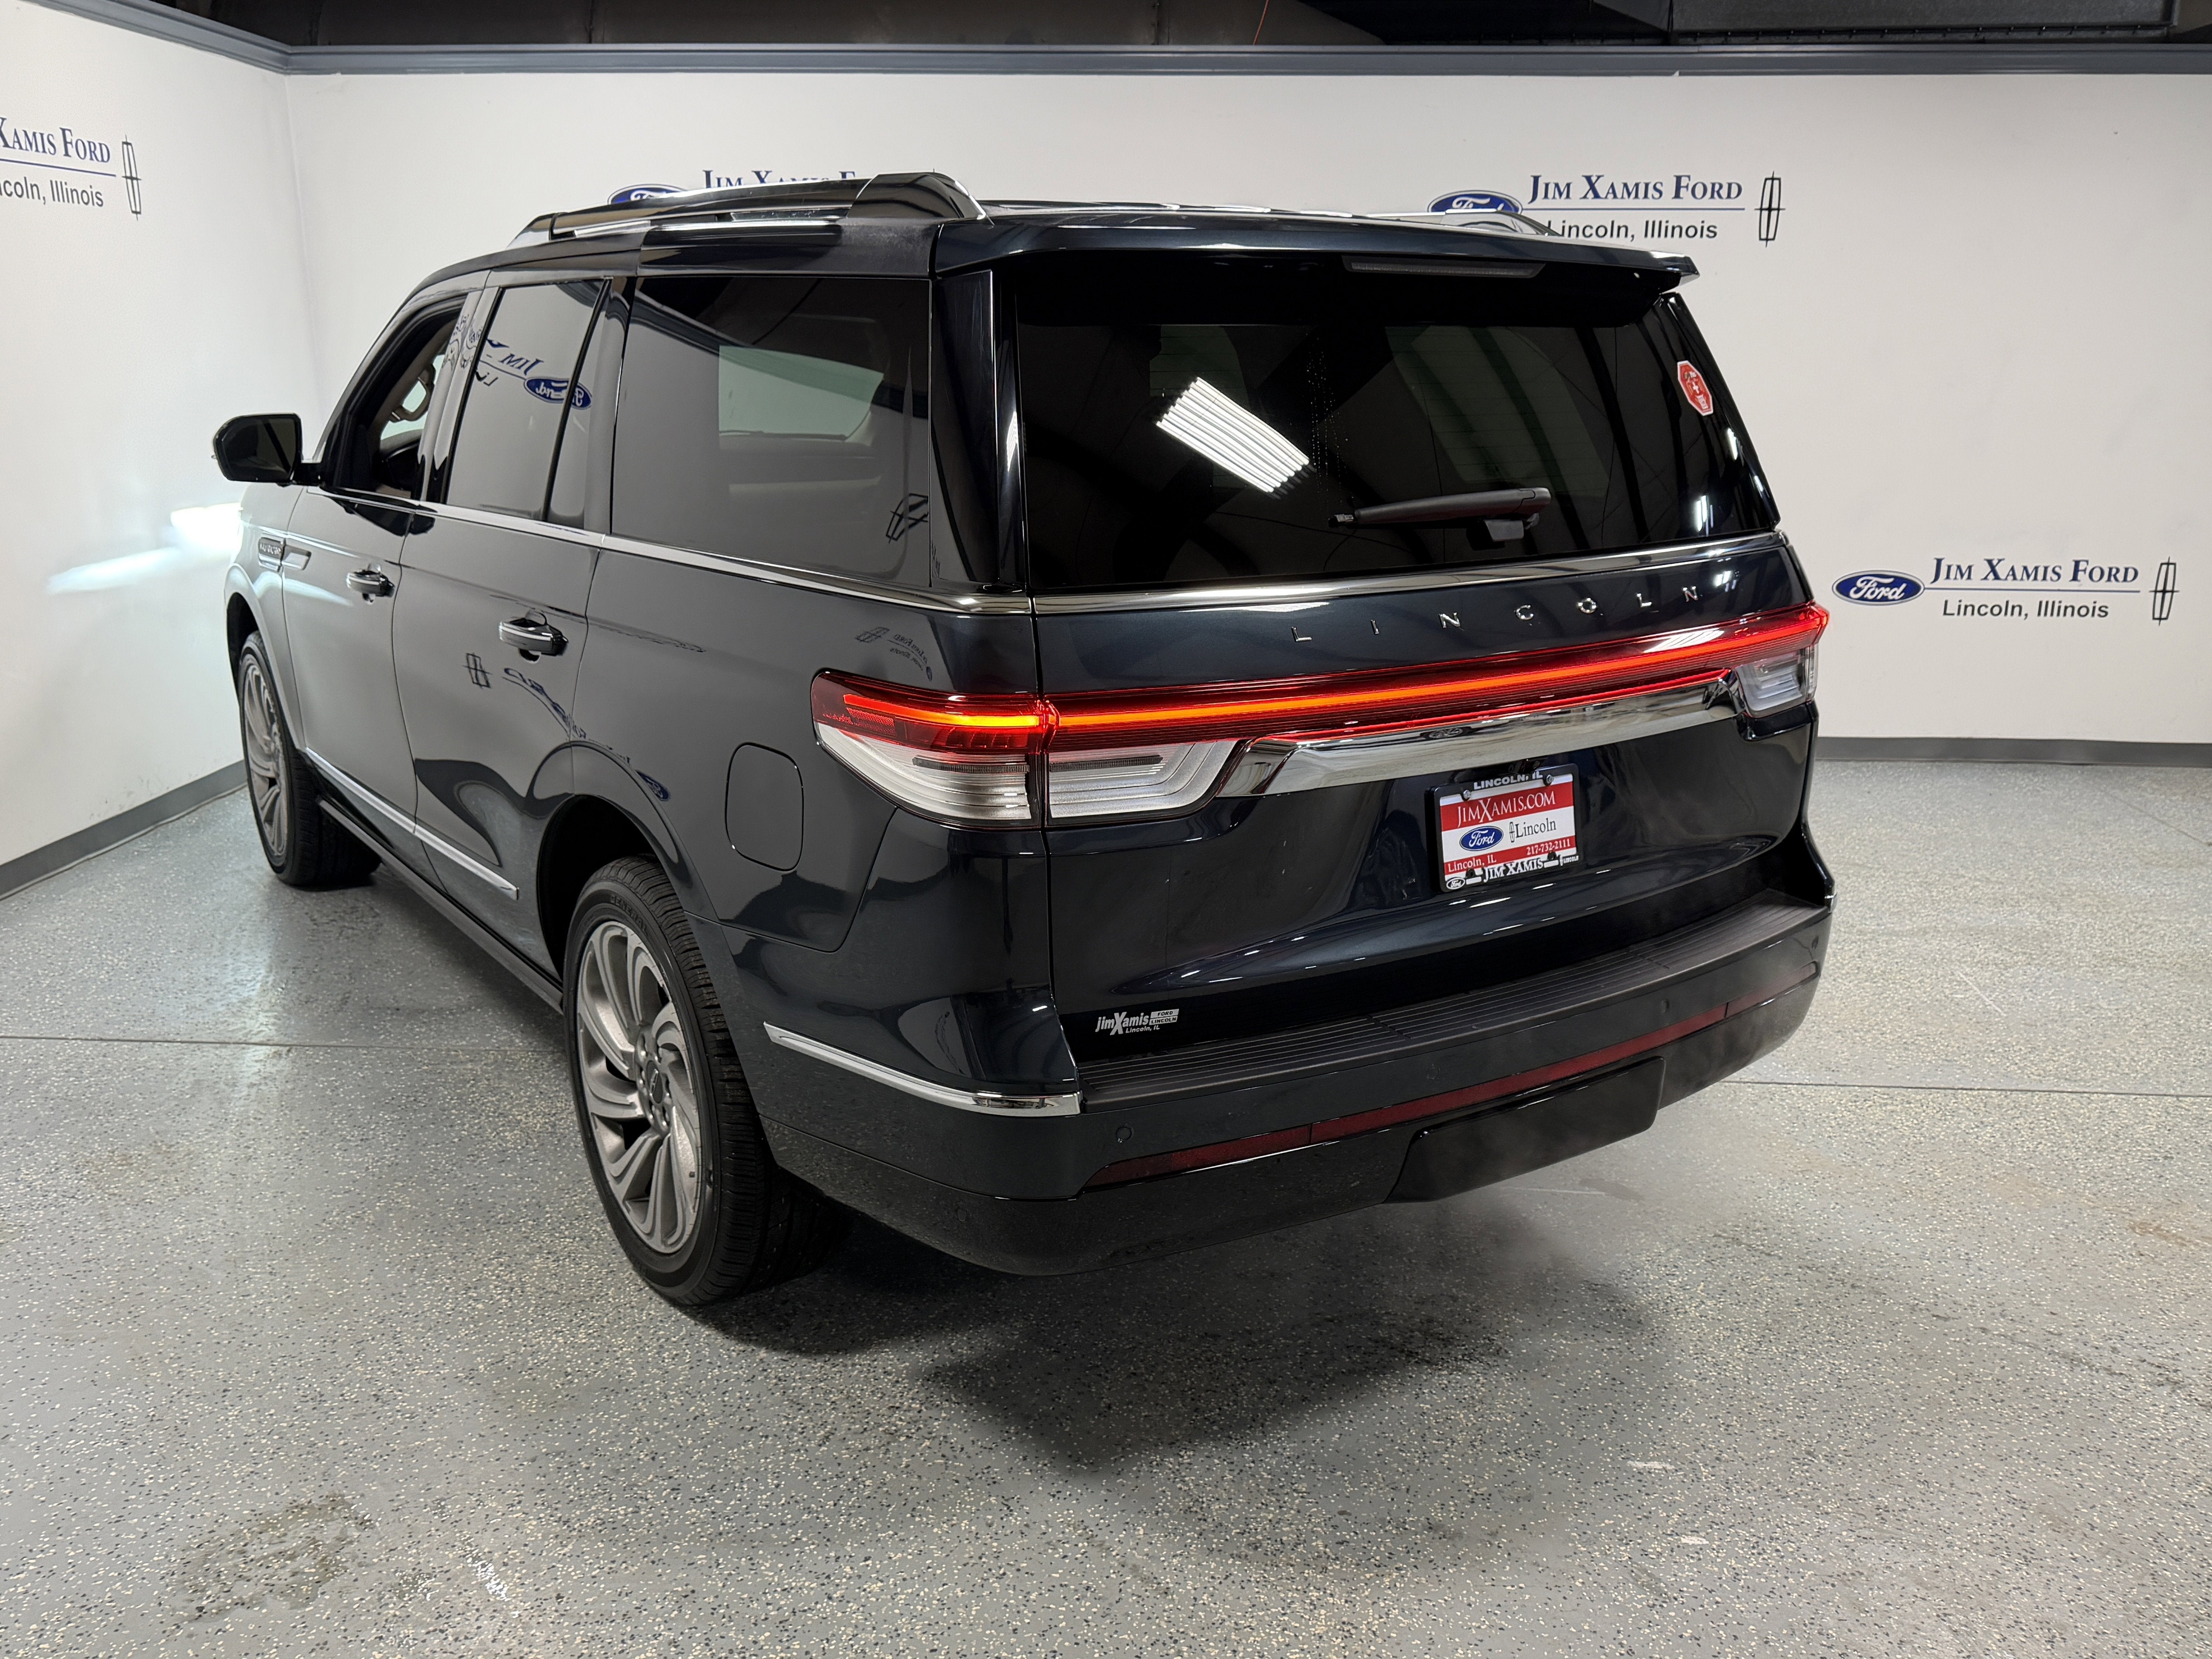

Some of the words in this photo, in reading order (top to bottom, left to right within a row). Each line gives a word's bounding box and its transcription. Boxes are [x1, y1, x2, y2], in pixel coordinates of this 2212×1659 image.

[59, 127, 110, 163] FORD
[50, 179, 104, 207] Illinois
[1528, 175, 1572, 204] JIM
[1579, 174, 1663, 200] XAMIS
[1671, 175, 1743, 200] FORD
[1644, 220, 1718, 239] Illinois
[1930, 557, 1974, 584] JIM
[1980, 558, 2062, 582] XAMIS
[2069, 559, 2139, 583] FORD
[1850, 576, 1907, 600] Ford
[1942, 599, 2028, 620] Lincoln,
[2037, 600, 2109, 618] Illinois
[1468, 830, 1495, 847] Ford
[1515, 817, 1556, 838] Lincoln
[1527, 838, 1570, 855] 217-732-2111
[1487, 854, 1497, 864] IL
[1483, 865, 1506, 883] JIM
[1506, 859, 1543, 876] XAMIS
